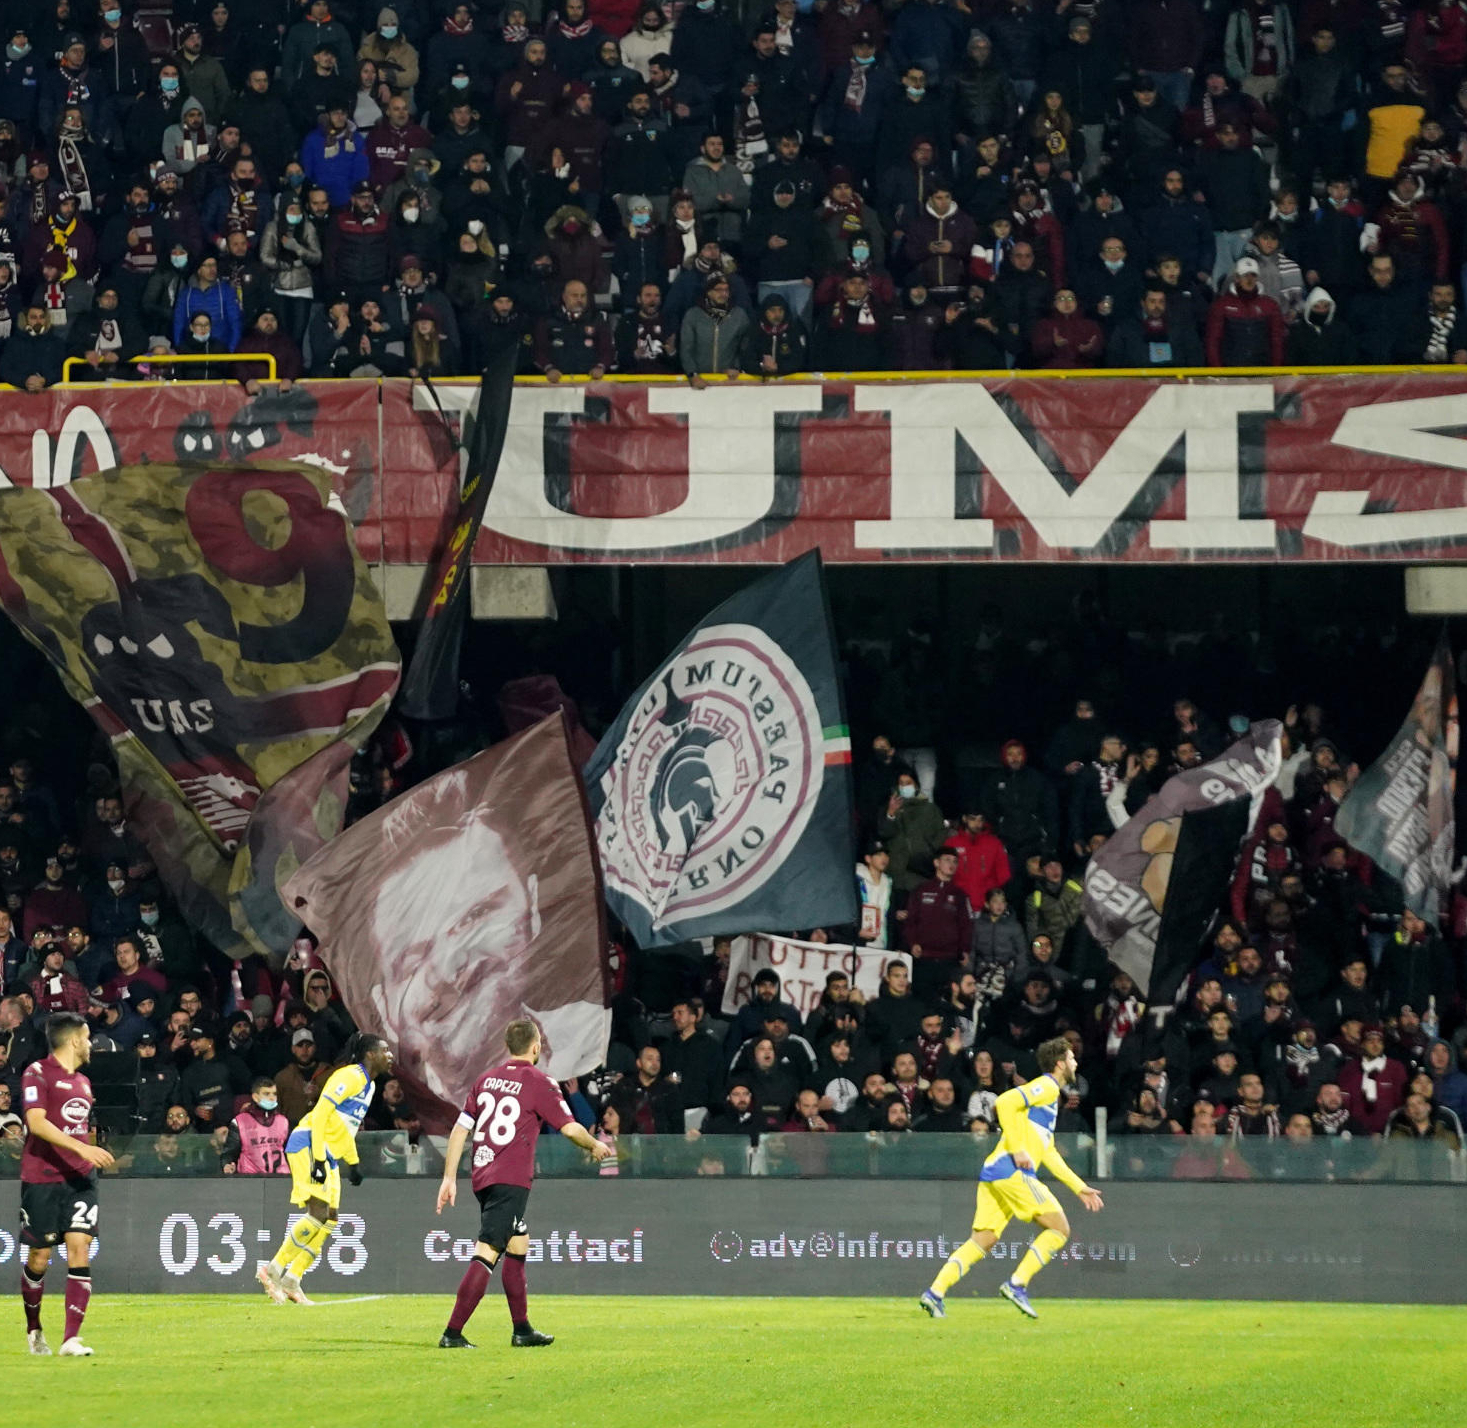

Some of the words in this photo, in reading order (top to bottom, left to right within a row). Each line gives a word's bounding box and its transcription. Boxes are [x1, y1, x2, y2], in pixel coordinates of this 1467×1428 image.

[483, 1077, 524, 1096] CAPEZZI
[472, 1091, 521, 1147] 28
[71, 1200, 100, 1227] 24
[424, 1228, 644, 1263] Coattaci
